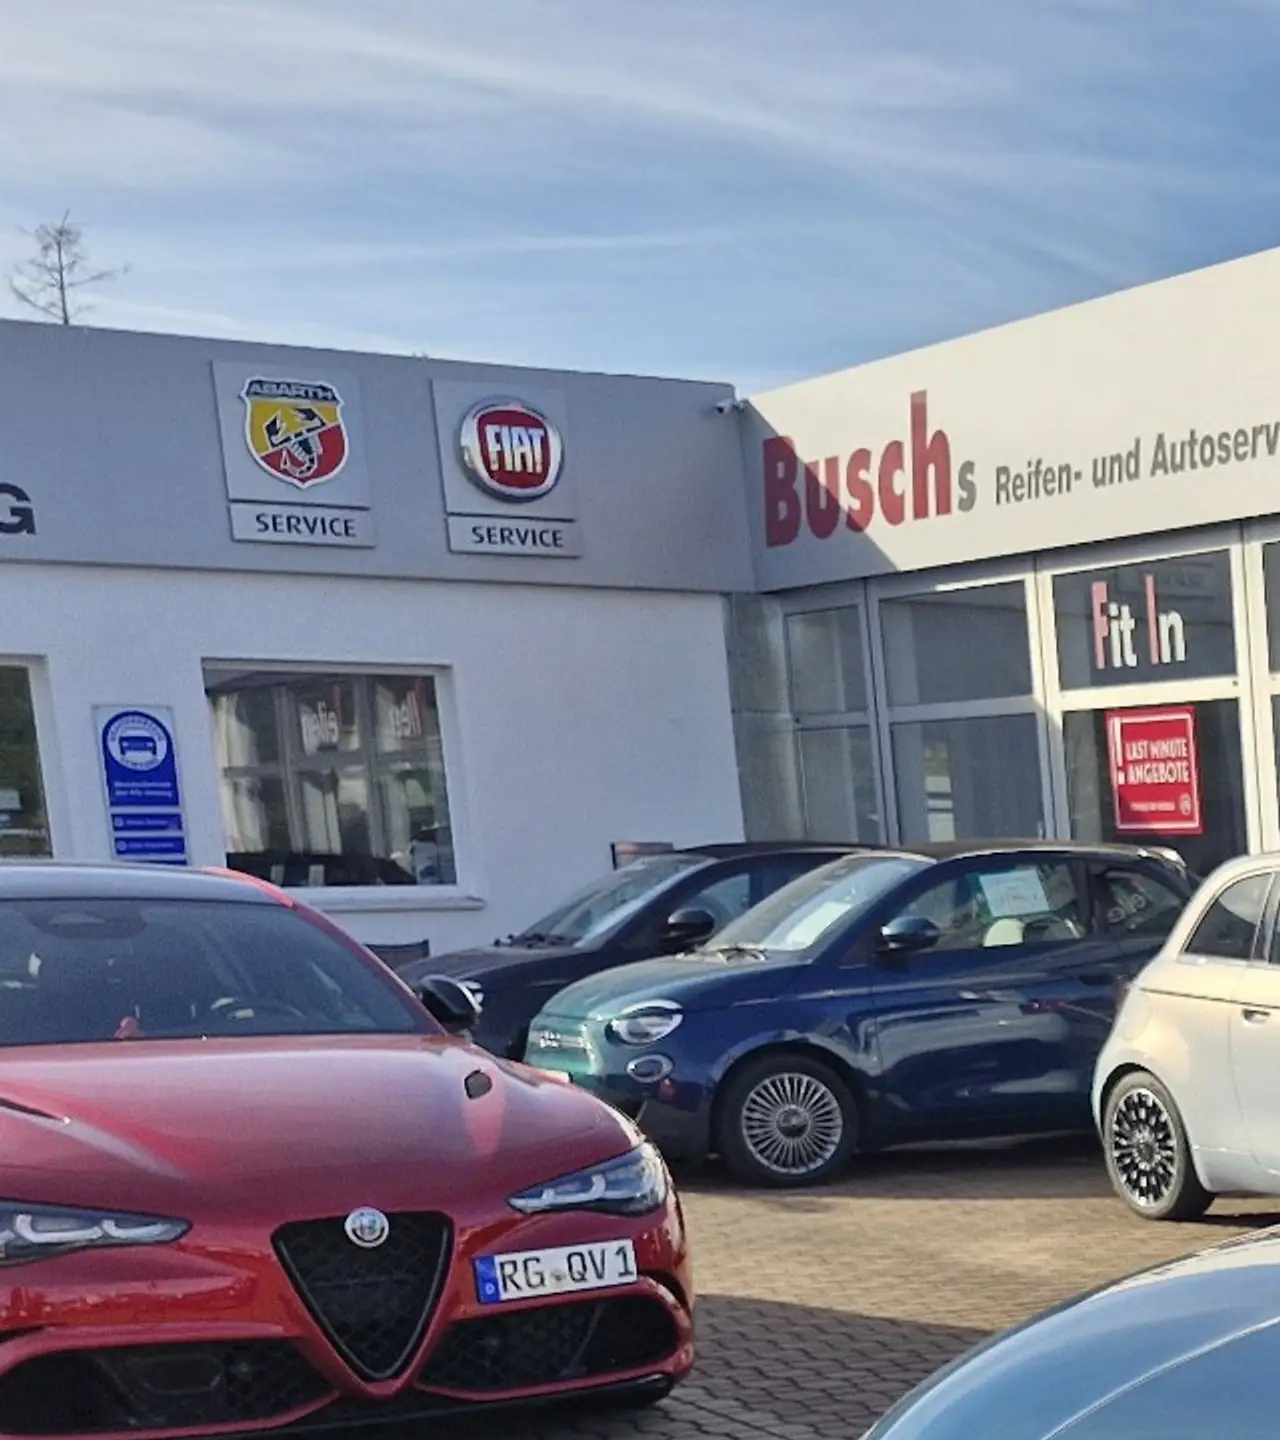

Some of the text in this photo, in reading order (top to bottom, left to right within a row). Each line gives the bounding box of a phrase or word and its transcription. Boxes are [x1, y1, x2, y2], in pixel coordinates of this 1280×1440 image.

[249, 380, 335, 400] ABARTH
[484, 425, 547, 473] FIAT
[995, 458, 1082, 506] Reifen-
[1092, 438, 1141, 488] und
[256, 513, 356, 538] SERVICE
[472, 526, 564, 548] SERVICE
[1092, 581, 1137, 669] Fit
[1146, 574, 1185, 664] In
[1126, 737, 1188, 760] LAST MINUTE
[1127, 760, 1189, 784] ANGEBOTE
[499, 1256, 547, 1293] RG
